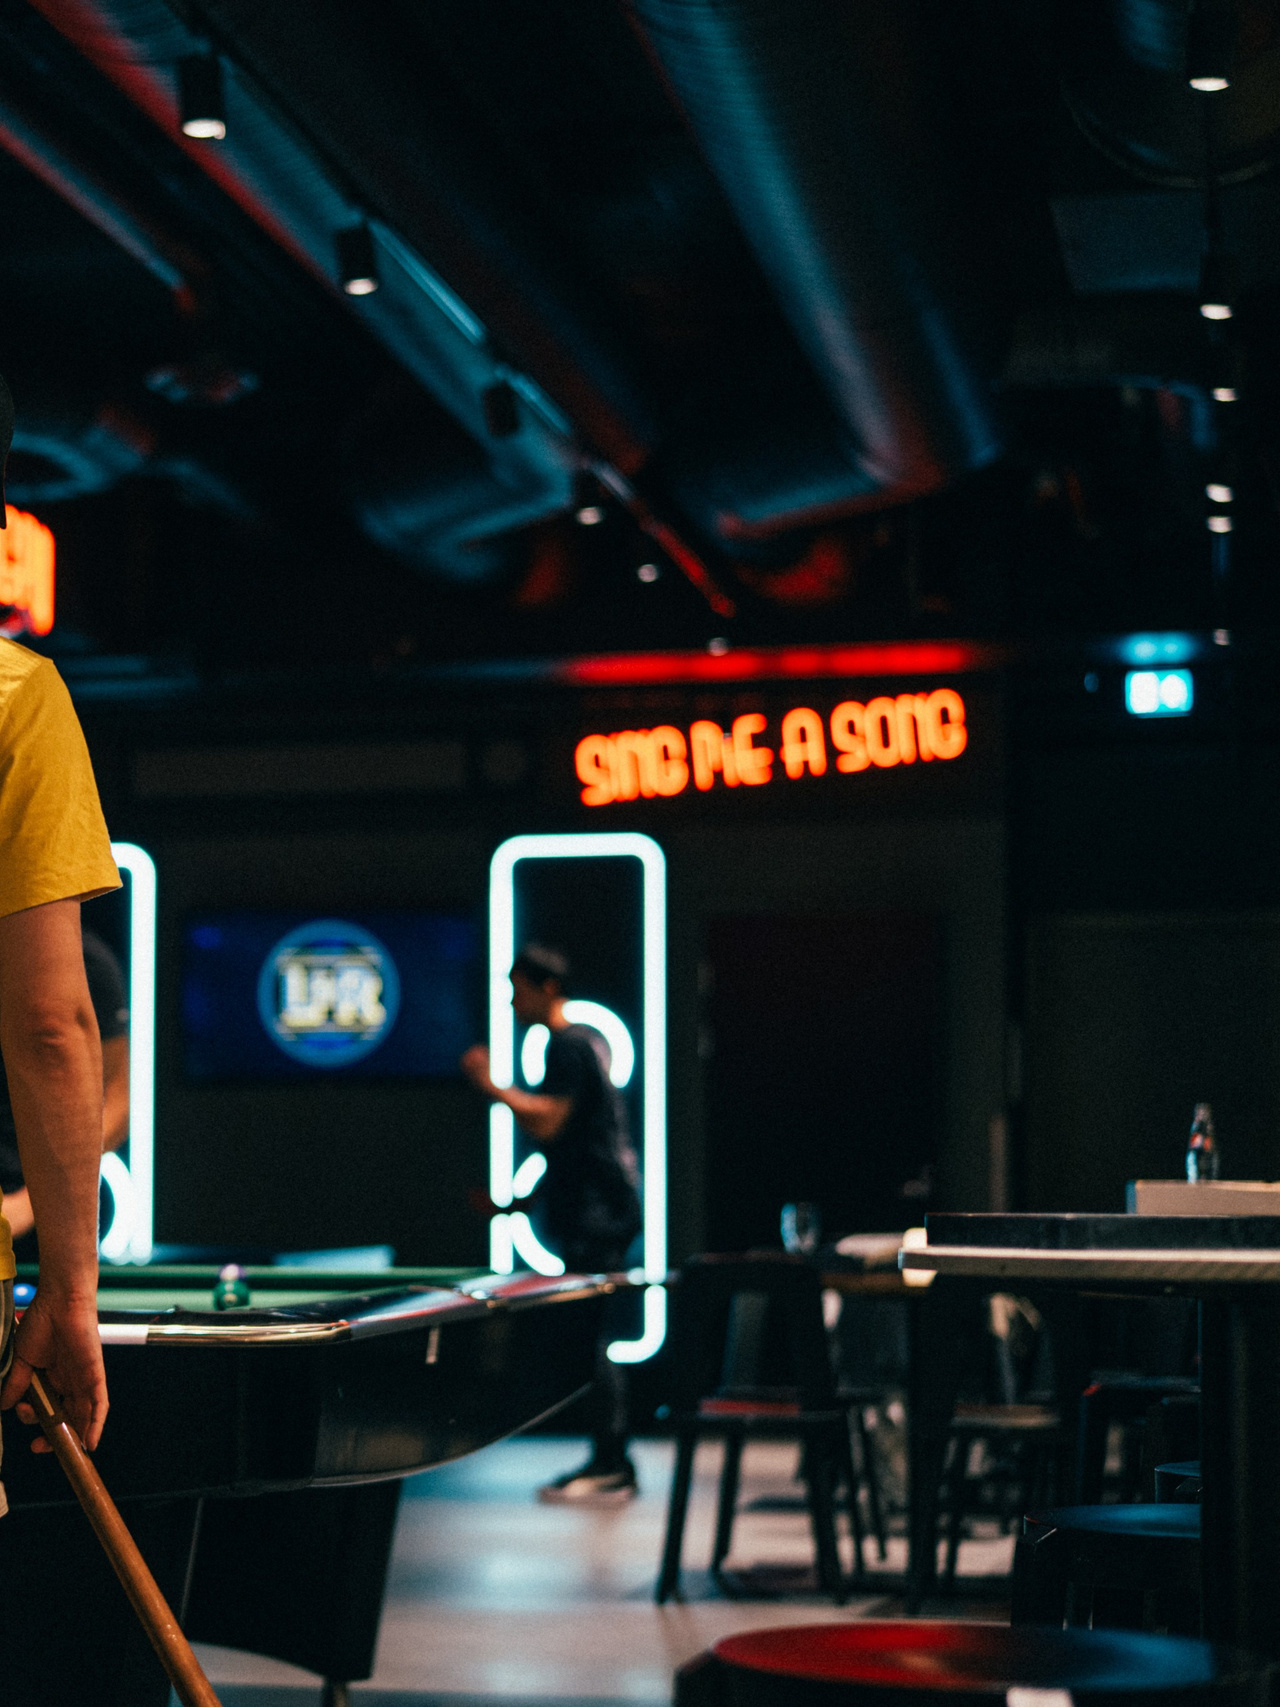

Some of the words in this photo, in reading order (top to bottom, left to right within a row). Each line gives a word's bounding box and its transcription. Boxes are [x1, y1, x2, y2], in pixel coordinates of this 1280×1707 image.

[574, 725, 689, 807] SING
[689, 713, 774, 792] ME
[780, 707, 827, 780] A
[830, 688, 968, 774] SONG
